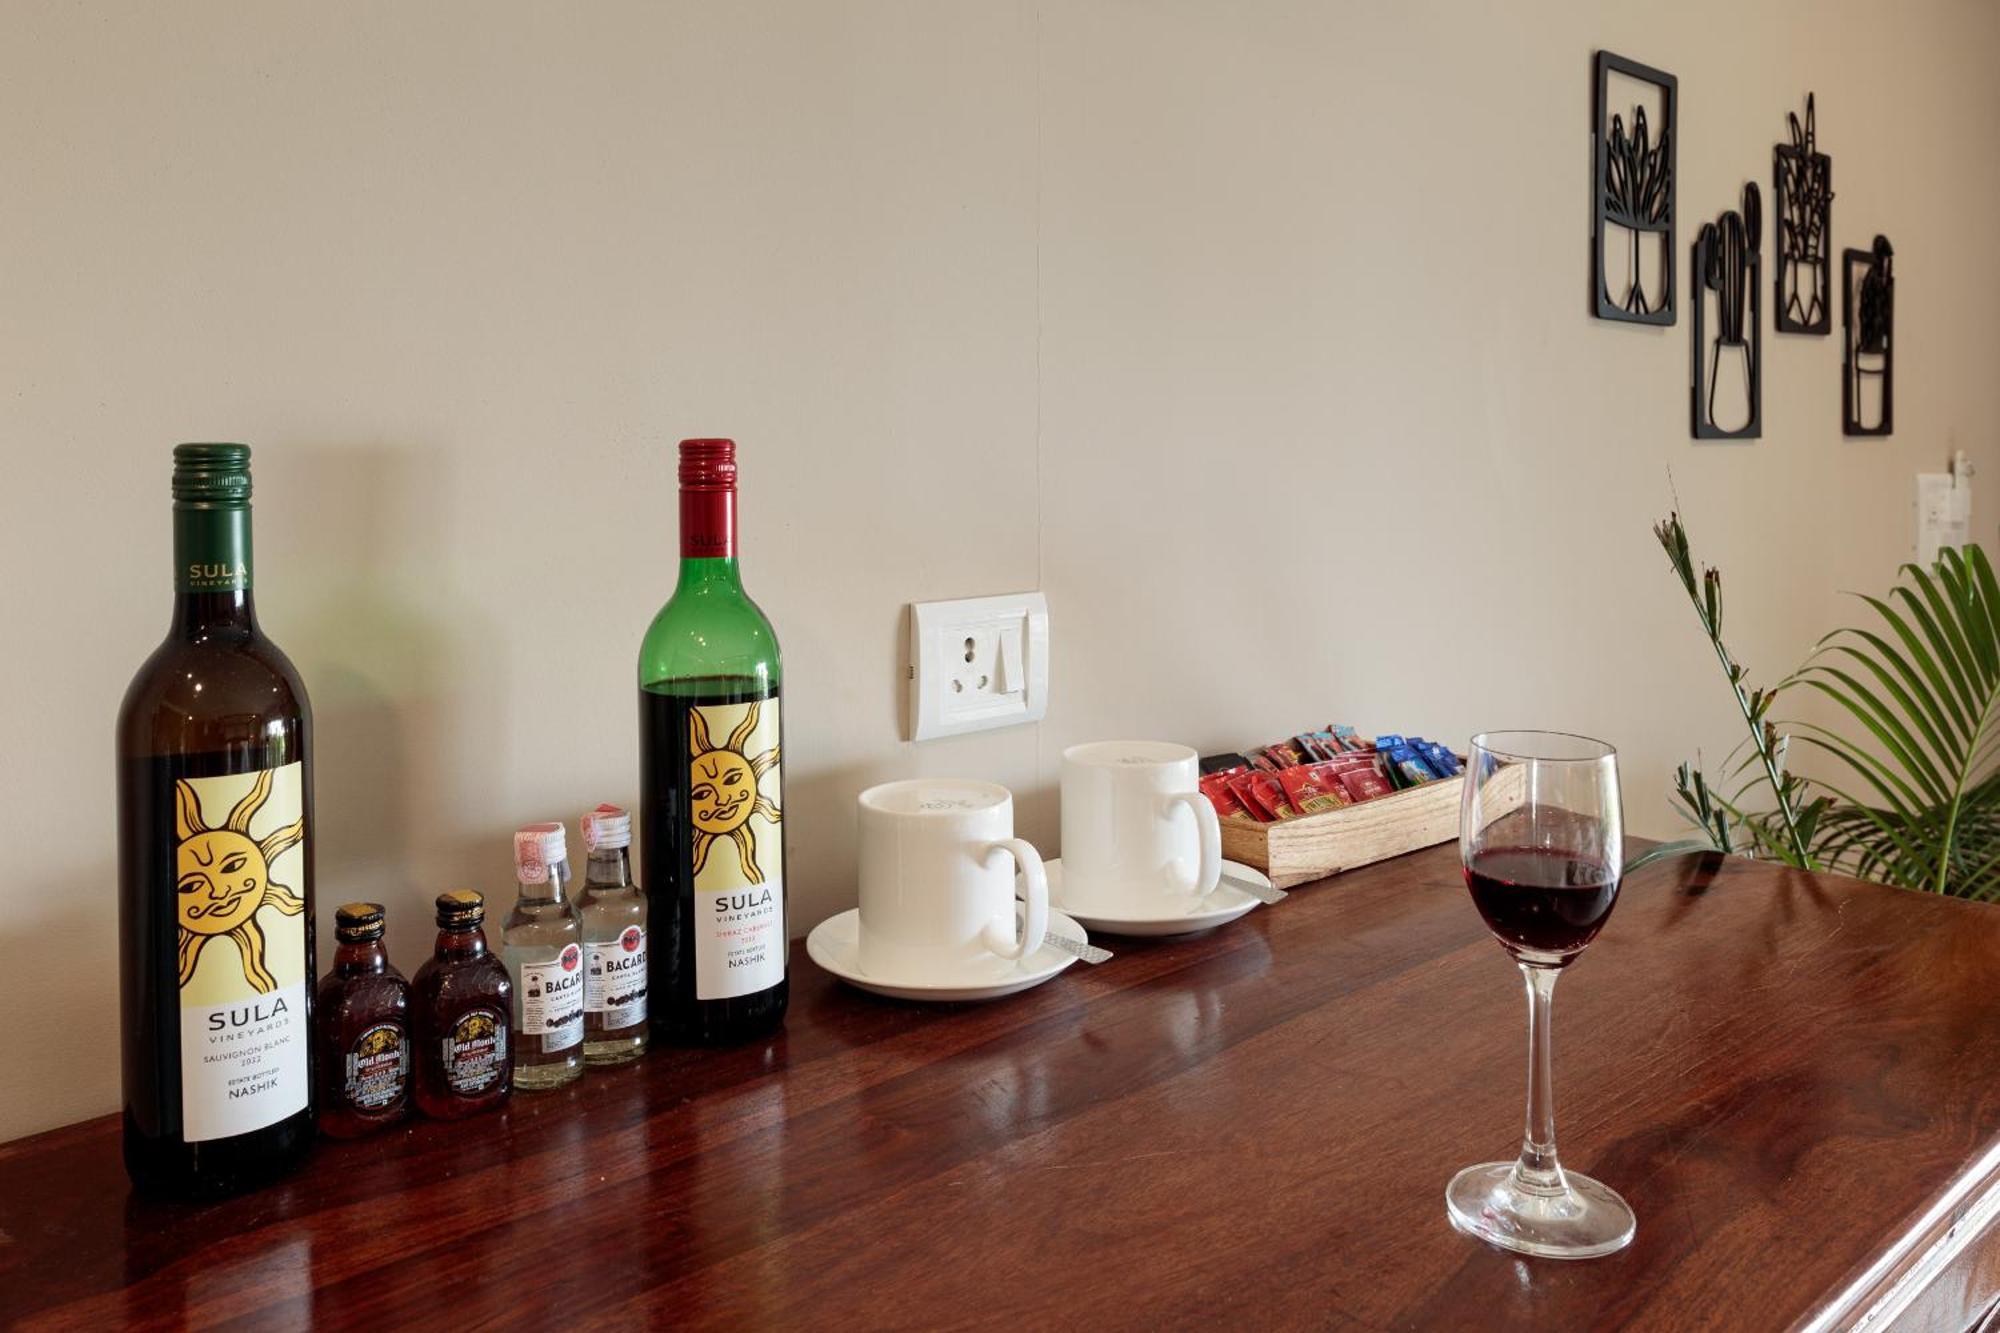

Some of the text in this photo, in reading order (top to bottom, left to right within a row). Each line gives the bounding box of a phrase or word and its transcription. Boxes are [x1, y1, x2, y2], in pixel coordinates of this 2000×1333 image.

[190, 561, 248, 578] SULA
[715, 889, 772, 912] SULA
[716, 906, 774, 923] VINEYARDS
[728, 952, 765, 968] NASHIK
[208, 997, 288, 1031] SULA
[209, 1018, 289, 1044] VINEYARDS
[203, 1035, 291, 1064] SAUVIGNON BLANC
[454, 1041, 470, 1053] Old
[358, 1057, 374, 1068] Old
[228, 1078, 278, 1100] NASHIK
